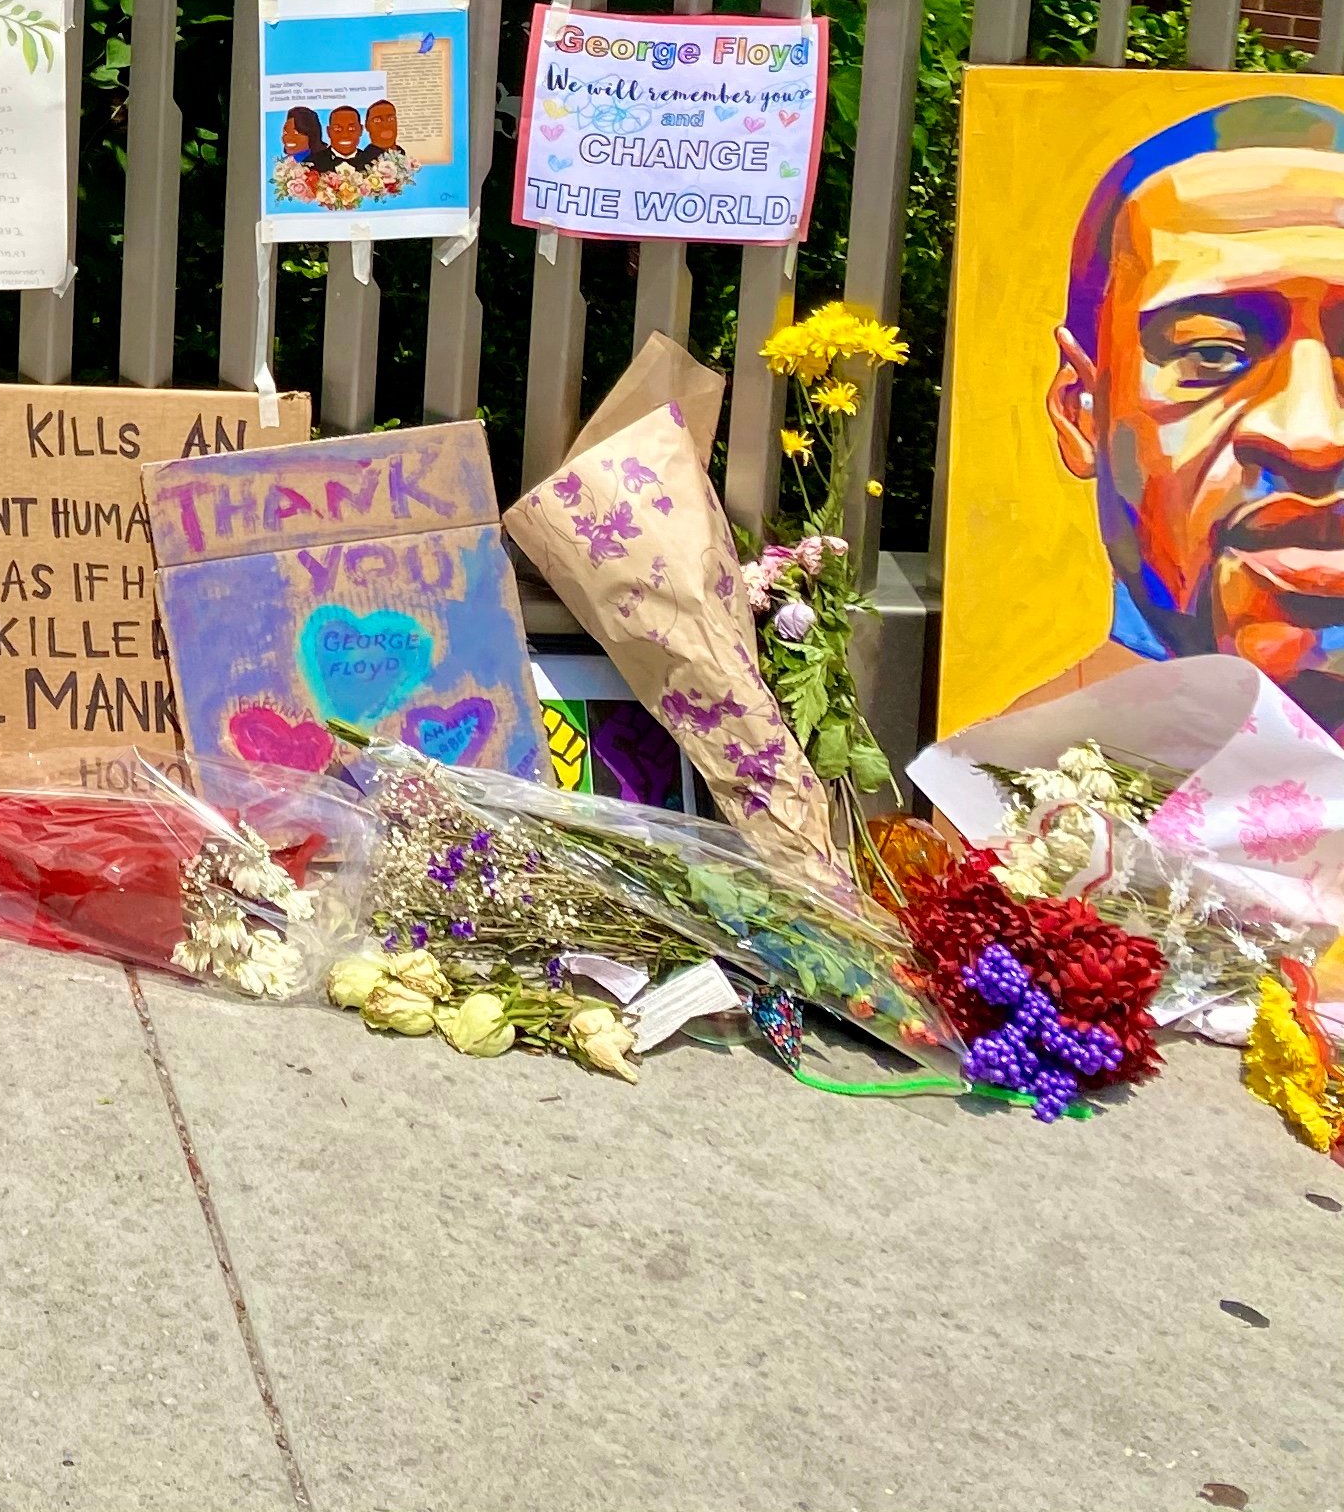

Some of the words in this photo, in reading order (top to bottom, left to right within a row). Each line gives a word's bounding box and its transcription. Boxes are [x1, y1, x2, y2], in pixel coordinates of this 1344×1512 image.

[556, 24, 701, 70] George
[713, 36, 809, 73] Floyd
[546, 64, 584, 92] We
[587, 79, 644, 102] will
[648, 82, 756, 104] remember
[661, 110, 704, 128] and
[579, 133, 769, 172] CHANGE
[528, 177, 621, 219] THE
[634, 191, 798, 226] WORLD.
[26, 403, 141, 460] KILLS
[180, 412, 247, 458] AN
[158, 454, 456, 552] THANK
[1, 559, 54, 603] AS
[72, 562, 109, 602] IF
[298, 540, 455, 594] YOU
[323, 631, 419, 651] GEORGE
[329, 658, 400, 679] FLOYD
